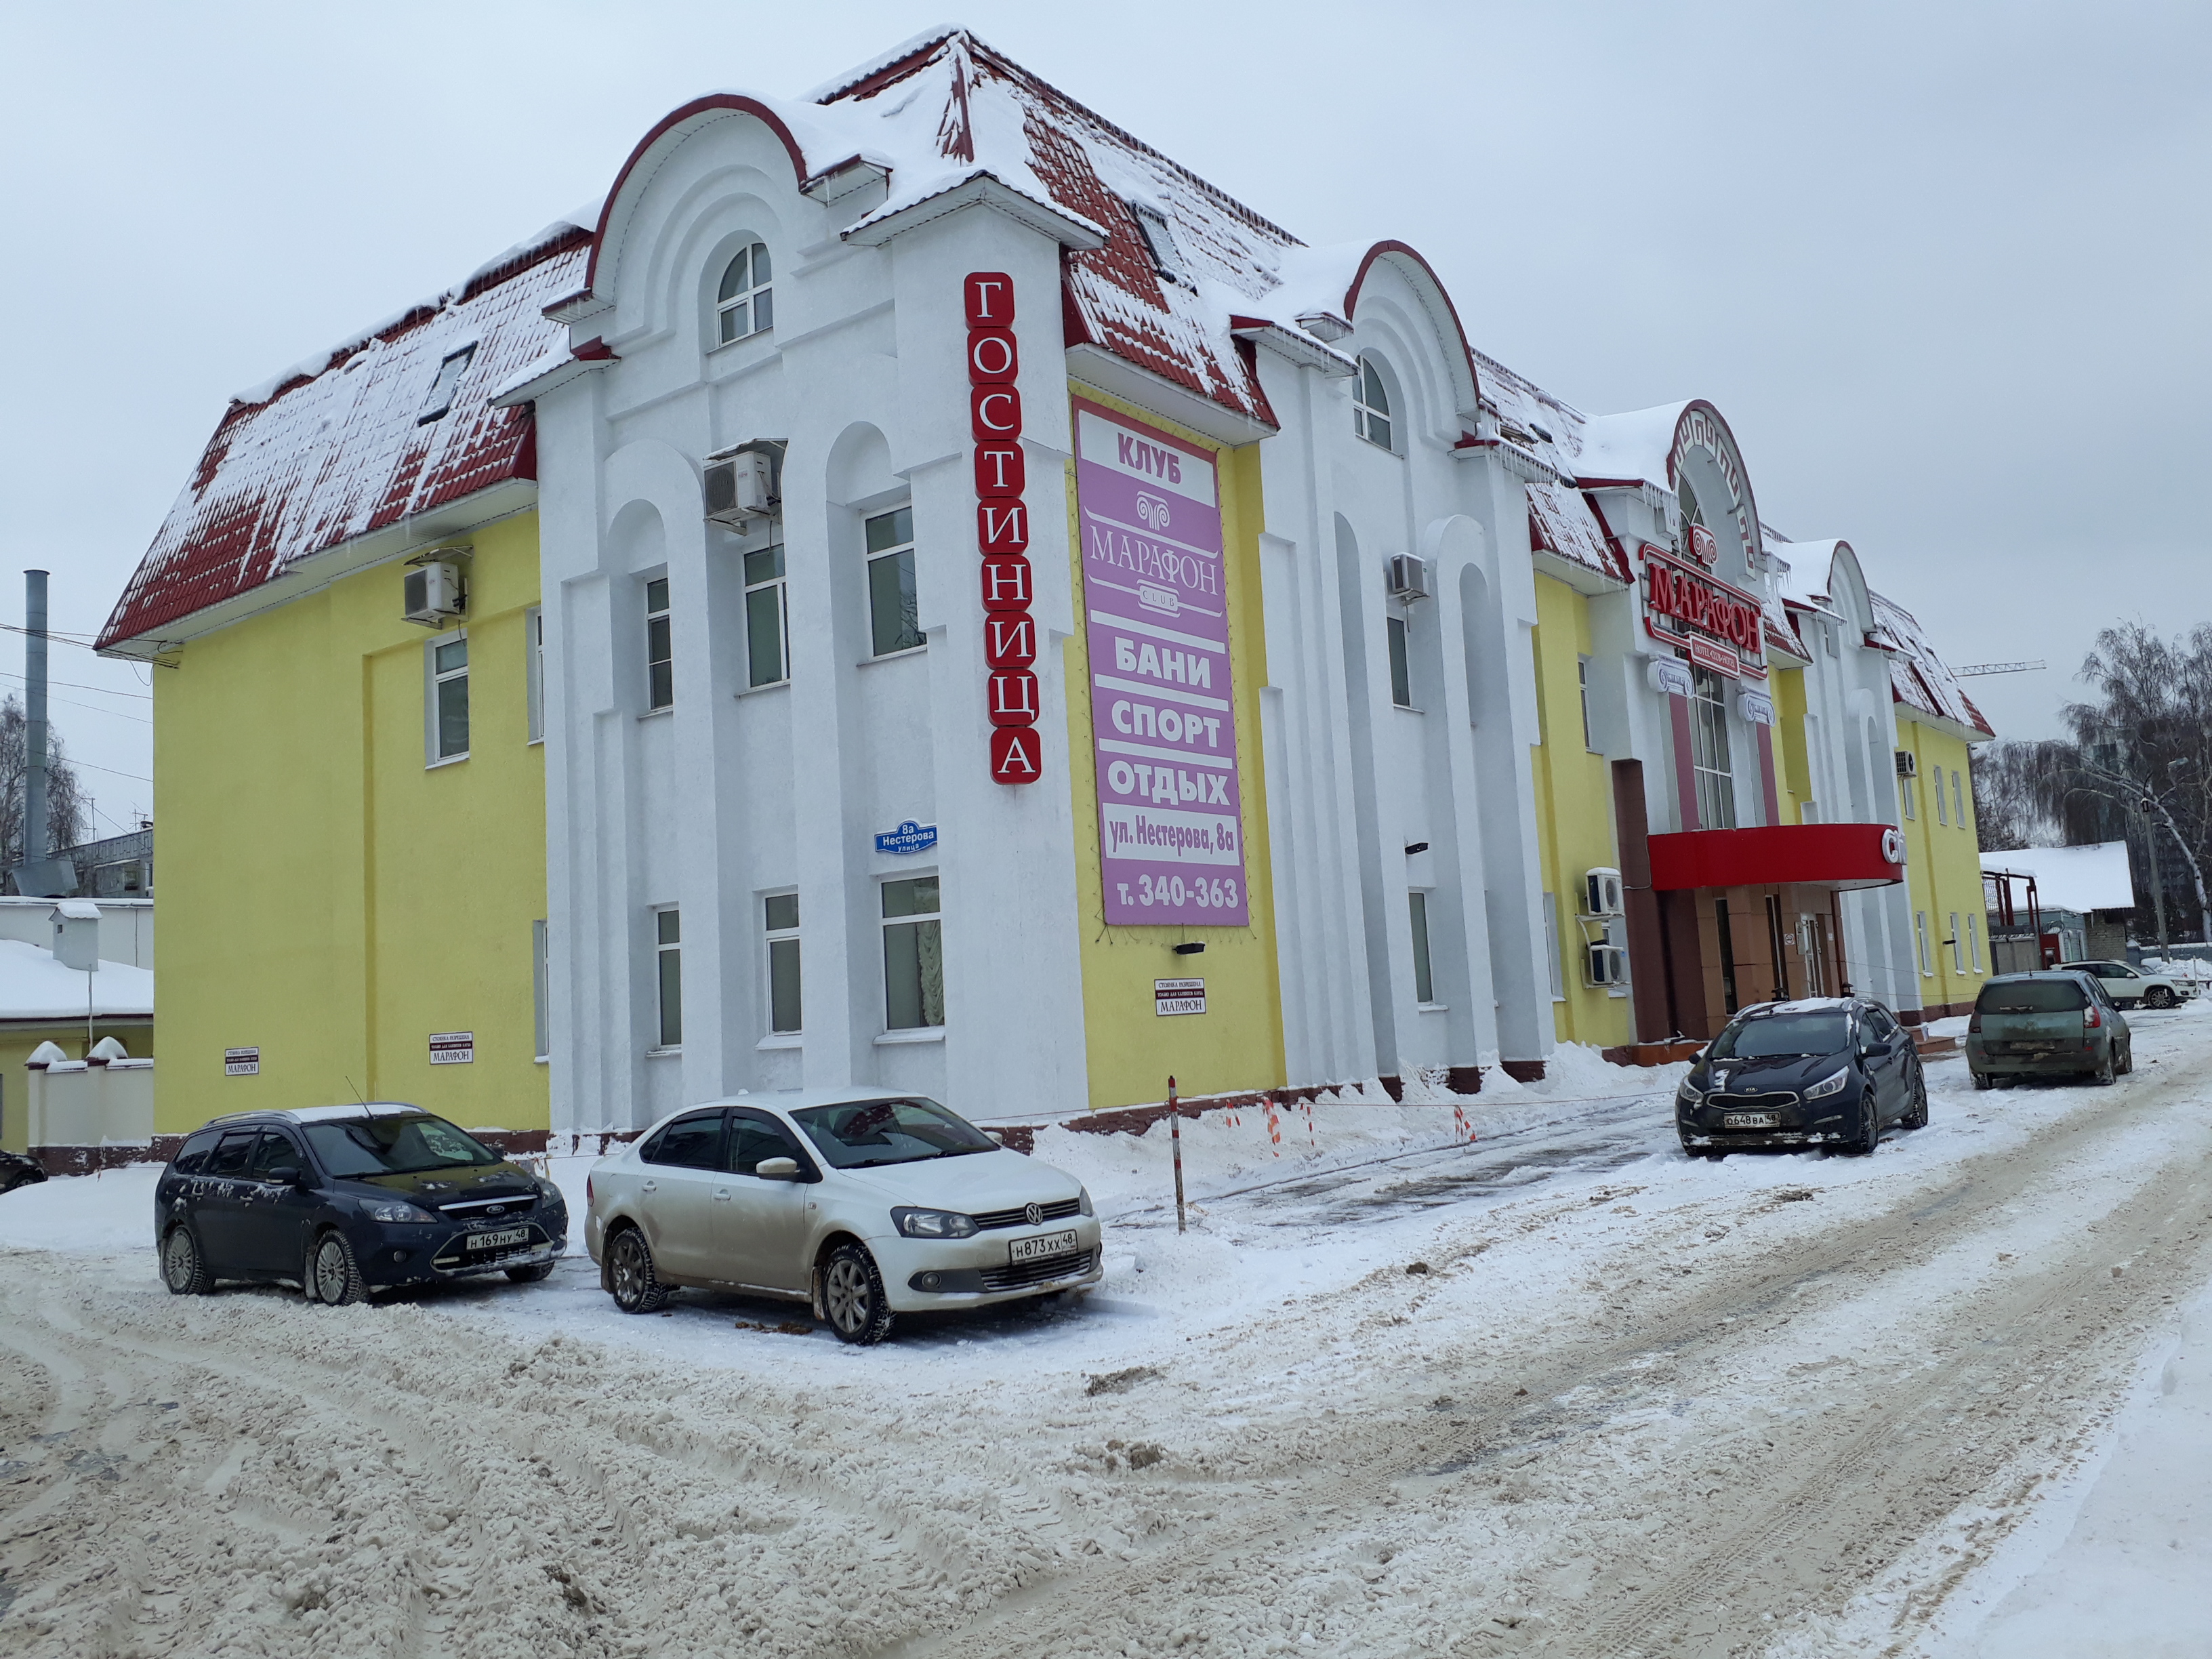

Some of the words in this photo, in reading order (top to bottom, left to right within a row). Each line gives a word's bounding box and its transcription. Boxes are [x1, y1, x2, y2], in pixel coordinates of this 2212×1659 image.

[1118, 432, 1181, 485] КЛУБ
[973, 281, 1036, 773] ГОСТИНИЦА
[1089, 525, 1218, 596] МАРАФОН
[1142, 590, 1175, 607] CLUB
[1647, 562, 1762, 655] МАРАФОН
[1114, 636, 1212, 689] БАНИ
[1111, 699, 1221, 748] СПОРТ
[1107, 760, 1231, 806] ОТДЫХ
[882, 831, 935, 846] Нестерова
[898, 843, 920, 853] улица
[902, 824, 914, 835] 8а
[1109, 821, 1134, 853] ул.
[1135, 815, 1214, 857] Нестерова,
[1216, 822, 1235, 852] 8а
[1116, 883, 1134, 906] т.
[1138, 874, 1239, 909] 340-363
[1160, 1000, 1202, 1012] МАРАФОН
[228, 1063, 256, 1073] МАРАФОН
[433, 1050, 469, 1062] МАРАФОН
